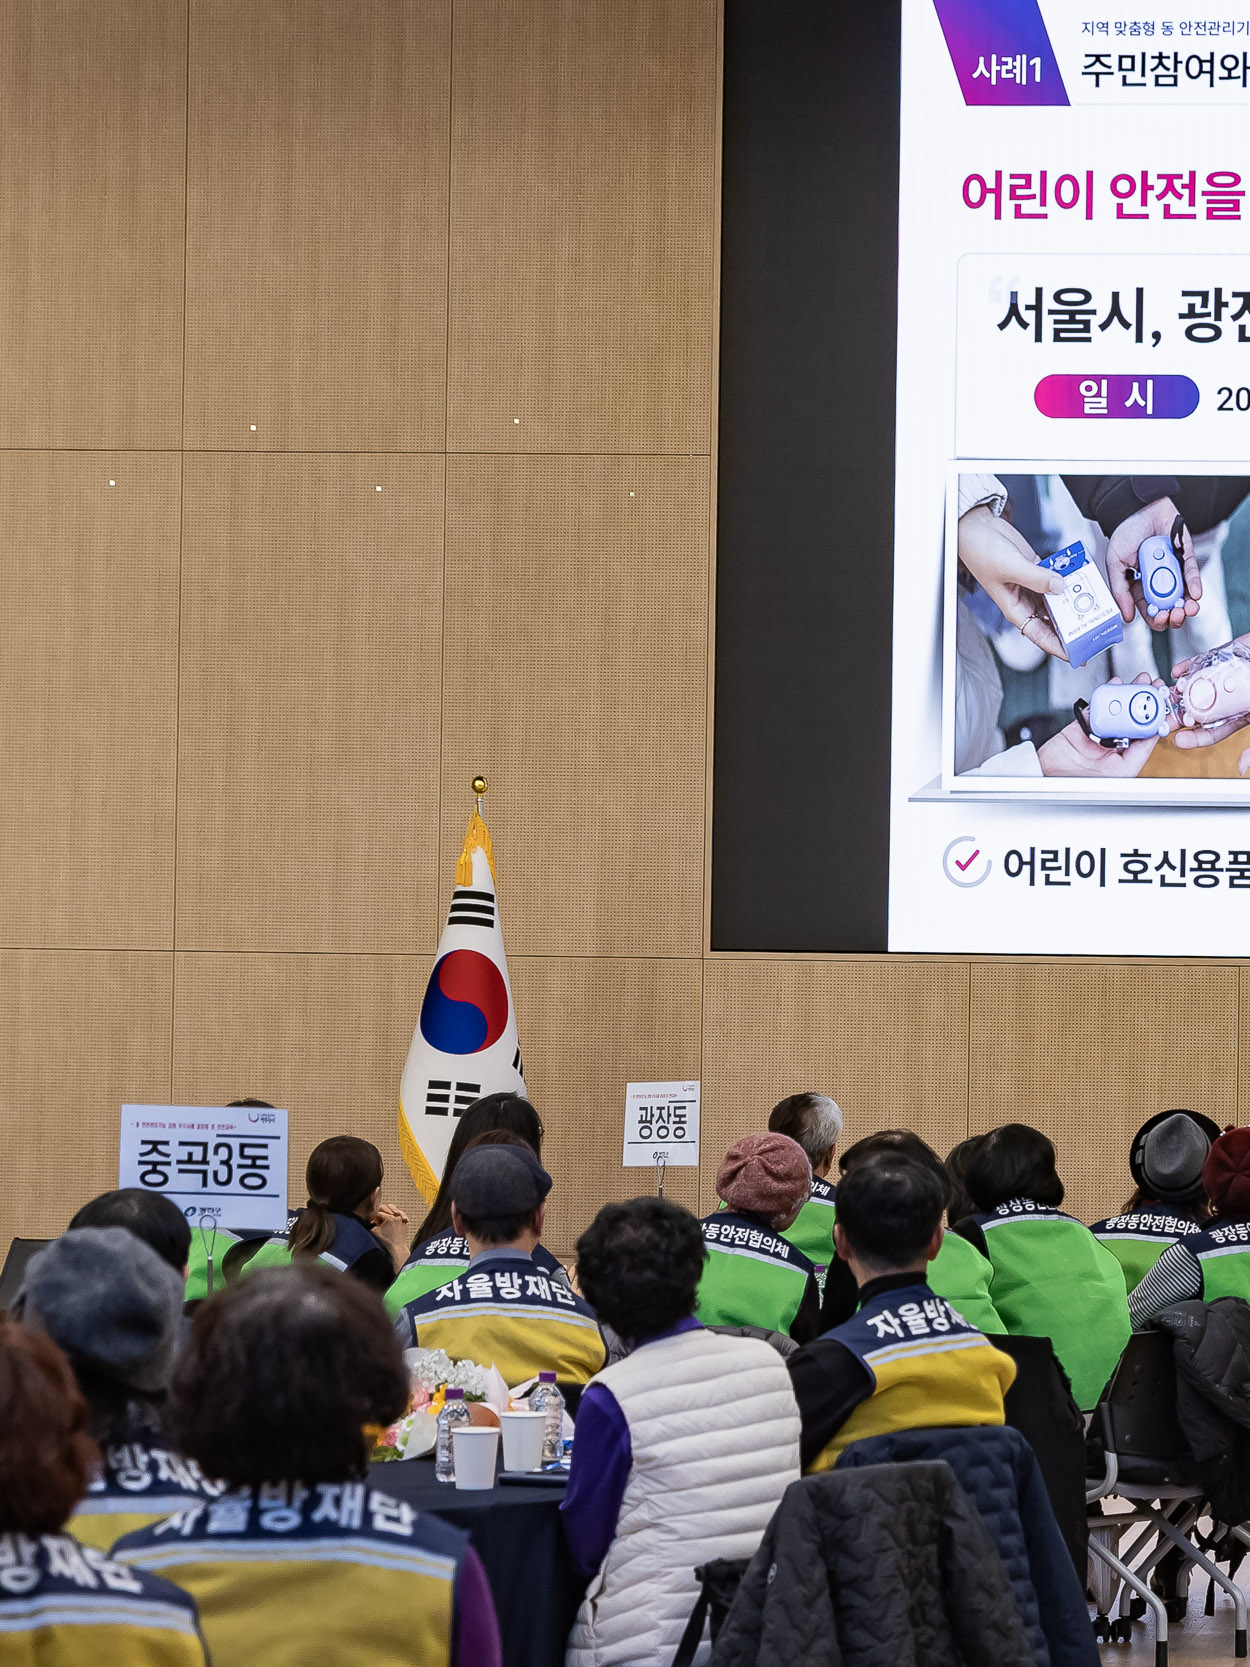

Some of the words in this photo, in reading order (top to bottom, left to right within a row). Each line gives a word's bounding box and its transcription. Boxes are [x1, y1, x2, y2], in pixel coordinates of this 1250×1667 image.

[1082, 21, 1108, 36] 지역
[1115, 21, 1154, 36] 맞춤형
[1161, 22, 1174, 36] 동
[971, 54, 1042, 87] 사례1
[962, 170, 1093, 220] 어린이
[1110, 170, 1245, 220] 안전을
[997, 287, 1161, 347] 서울시,
[1079, 379, 1109, 416] 일
[1126, 379, 1155, 416] 시
[1004, 847, 1106, 887] 어린이
[638, 1106, 687, 1140] 광장동
[137, 1139, 271, 1191] 중곡3동
[435, 1271, 576, 1306] 자율방재단
